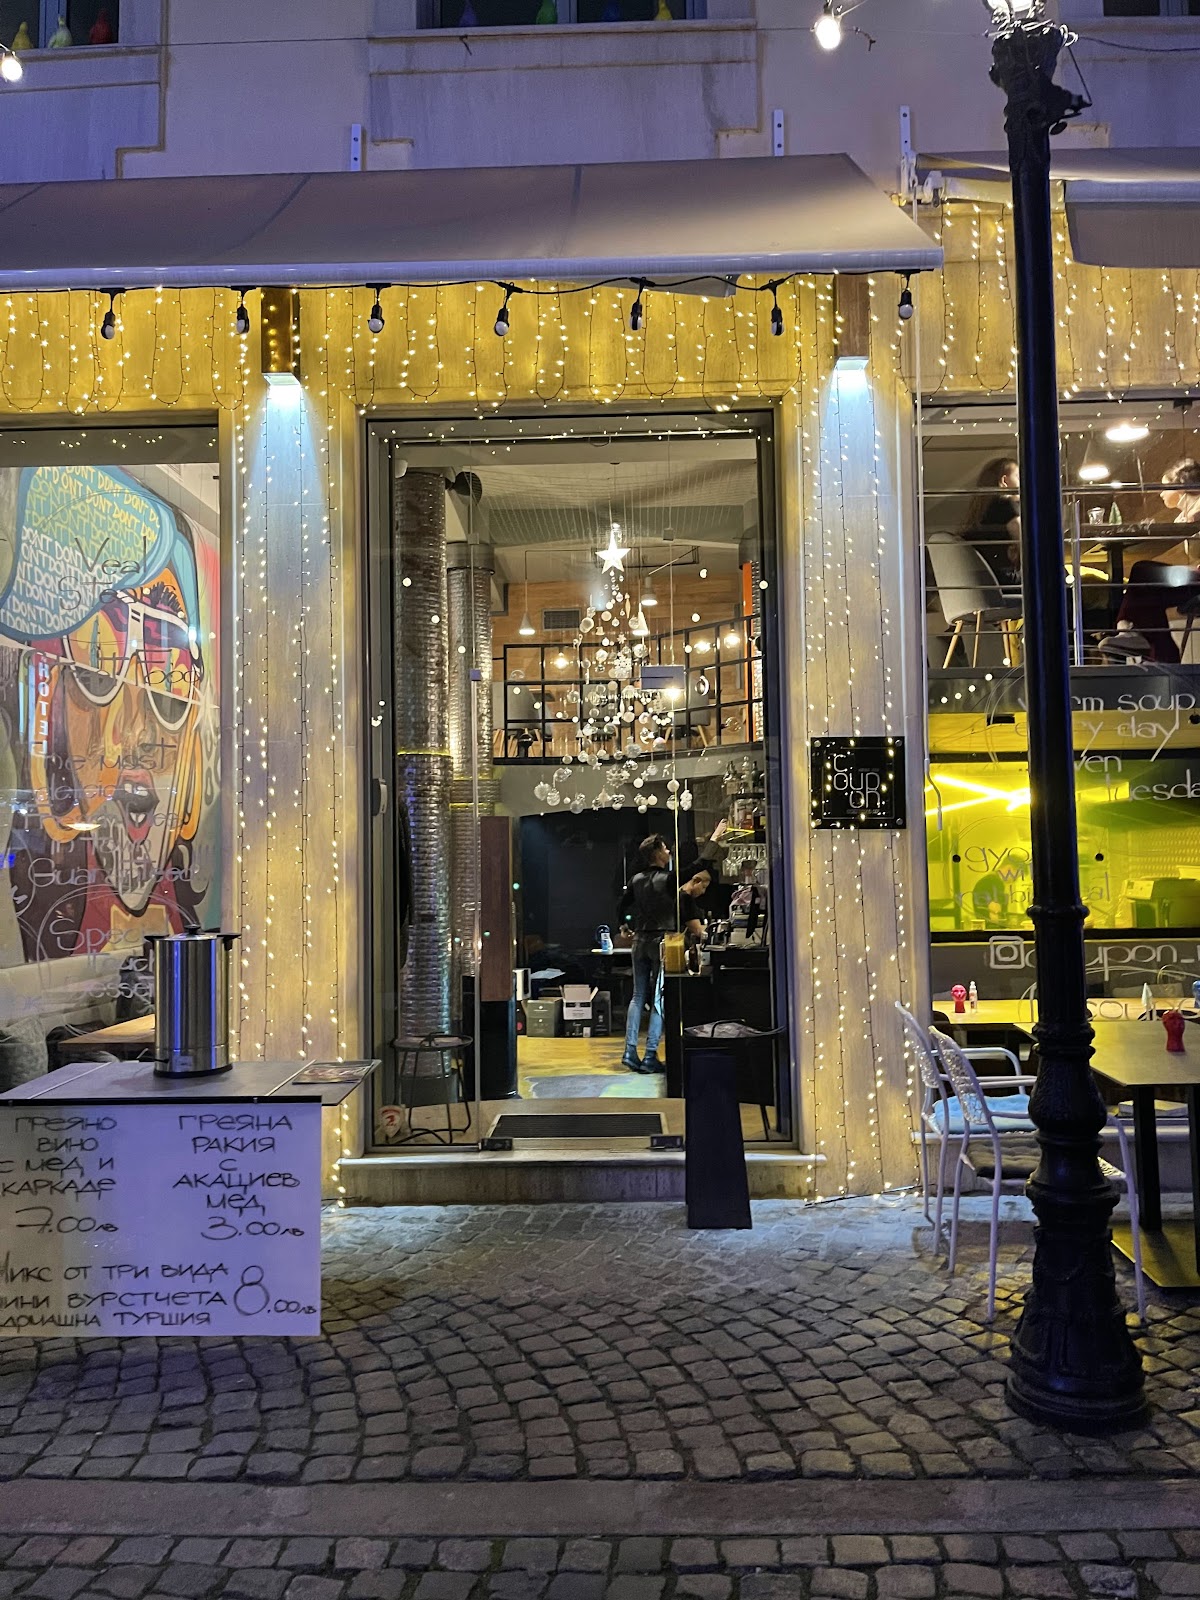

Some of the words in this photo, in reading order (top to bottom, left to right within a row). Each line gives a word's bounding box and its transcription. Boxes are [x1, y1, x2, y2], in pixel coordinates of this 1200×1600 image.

[74, 536, 147, 575] Veal
[1117, 693, 1196, 731] soup
[1117, 715, 1179, 762] day
[178, 1114, 293, 1131] ГРЕЯНА
[36, 1137, 99, 1153] ВИНО
[191, 1136, 276, 1154] РАКИЯ
[98, 1157, 114, 1170] И
[2, 1178, 116, 1202] КАРКАДЕ
[172, 1172, 301, 1195] АКАЦИЕВ
[64, 1265, 92, 1280] ОТ
[102, 1264, 149, 1281] ТРИ
[161, 1262, 228, 1283] ВИДА
[67, 1290, 228, 1309] ВУРСТЧЕТА
[113, 1310, 212, 1327] ТУРШИЯ
